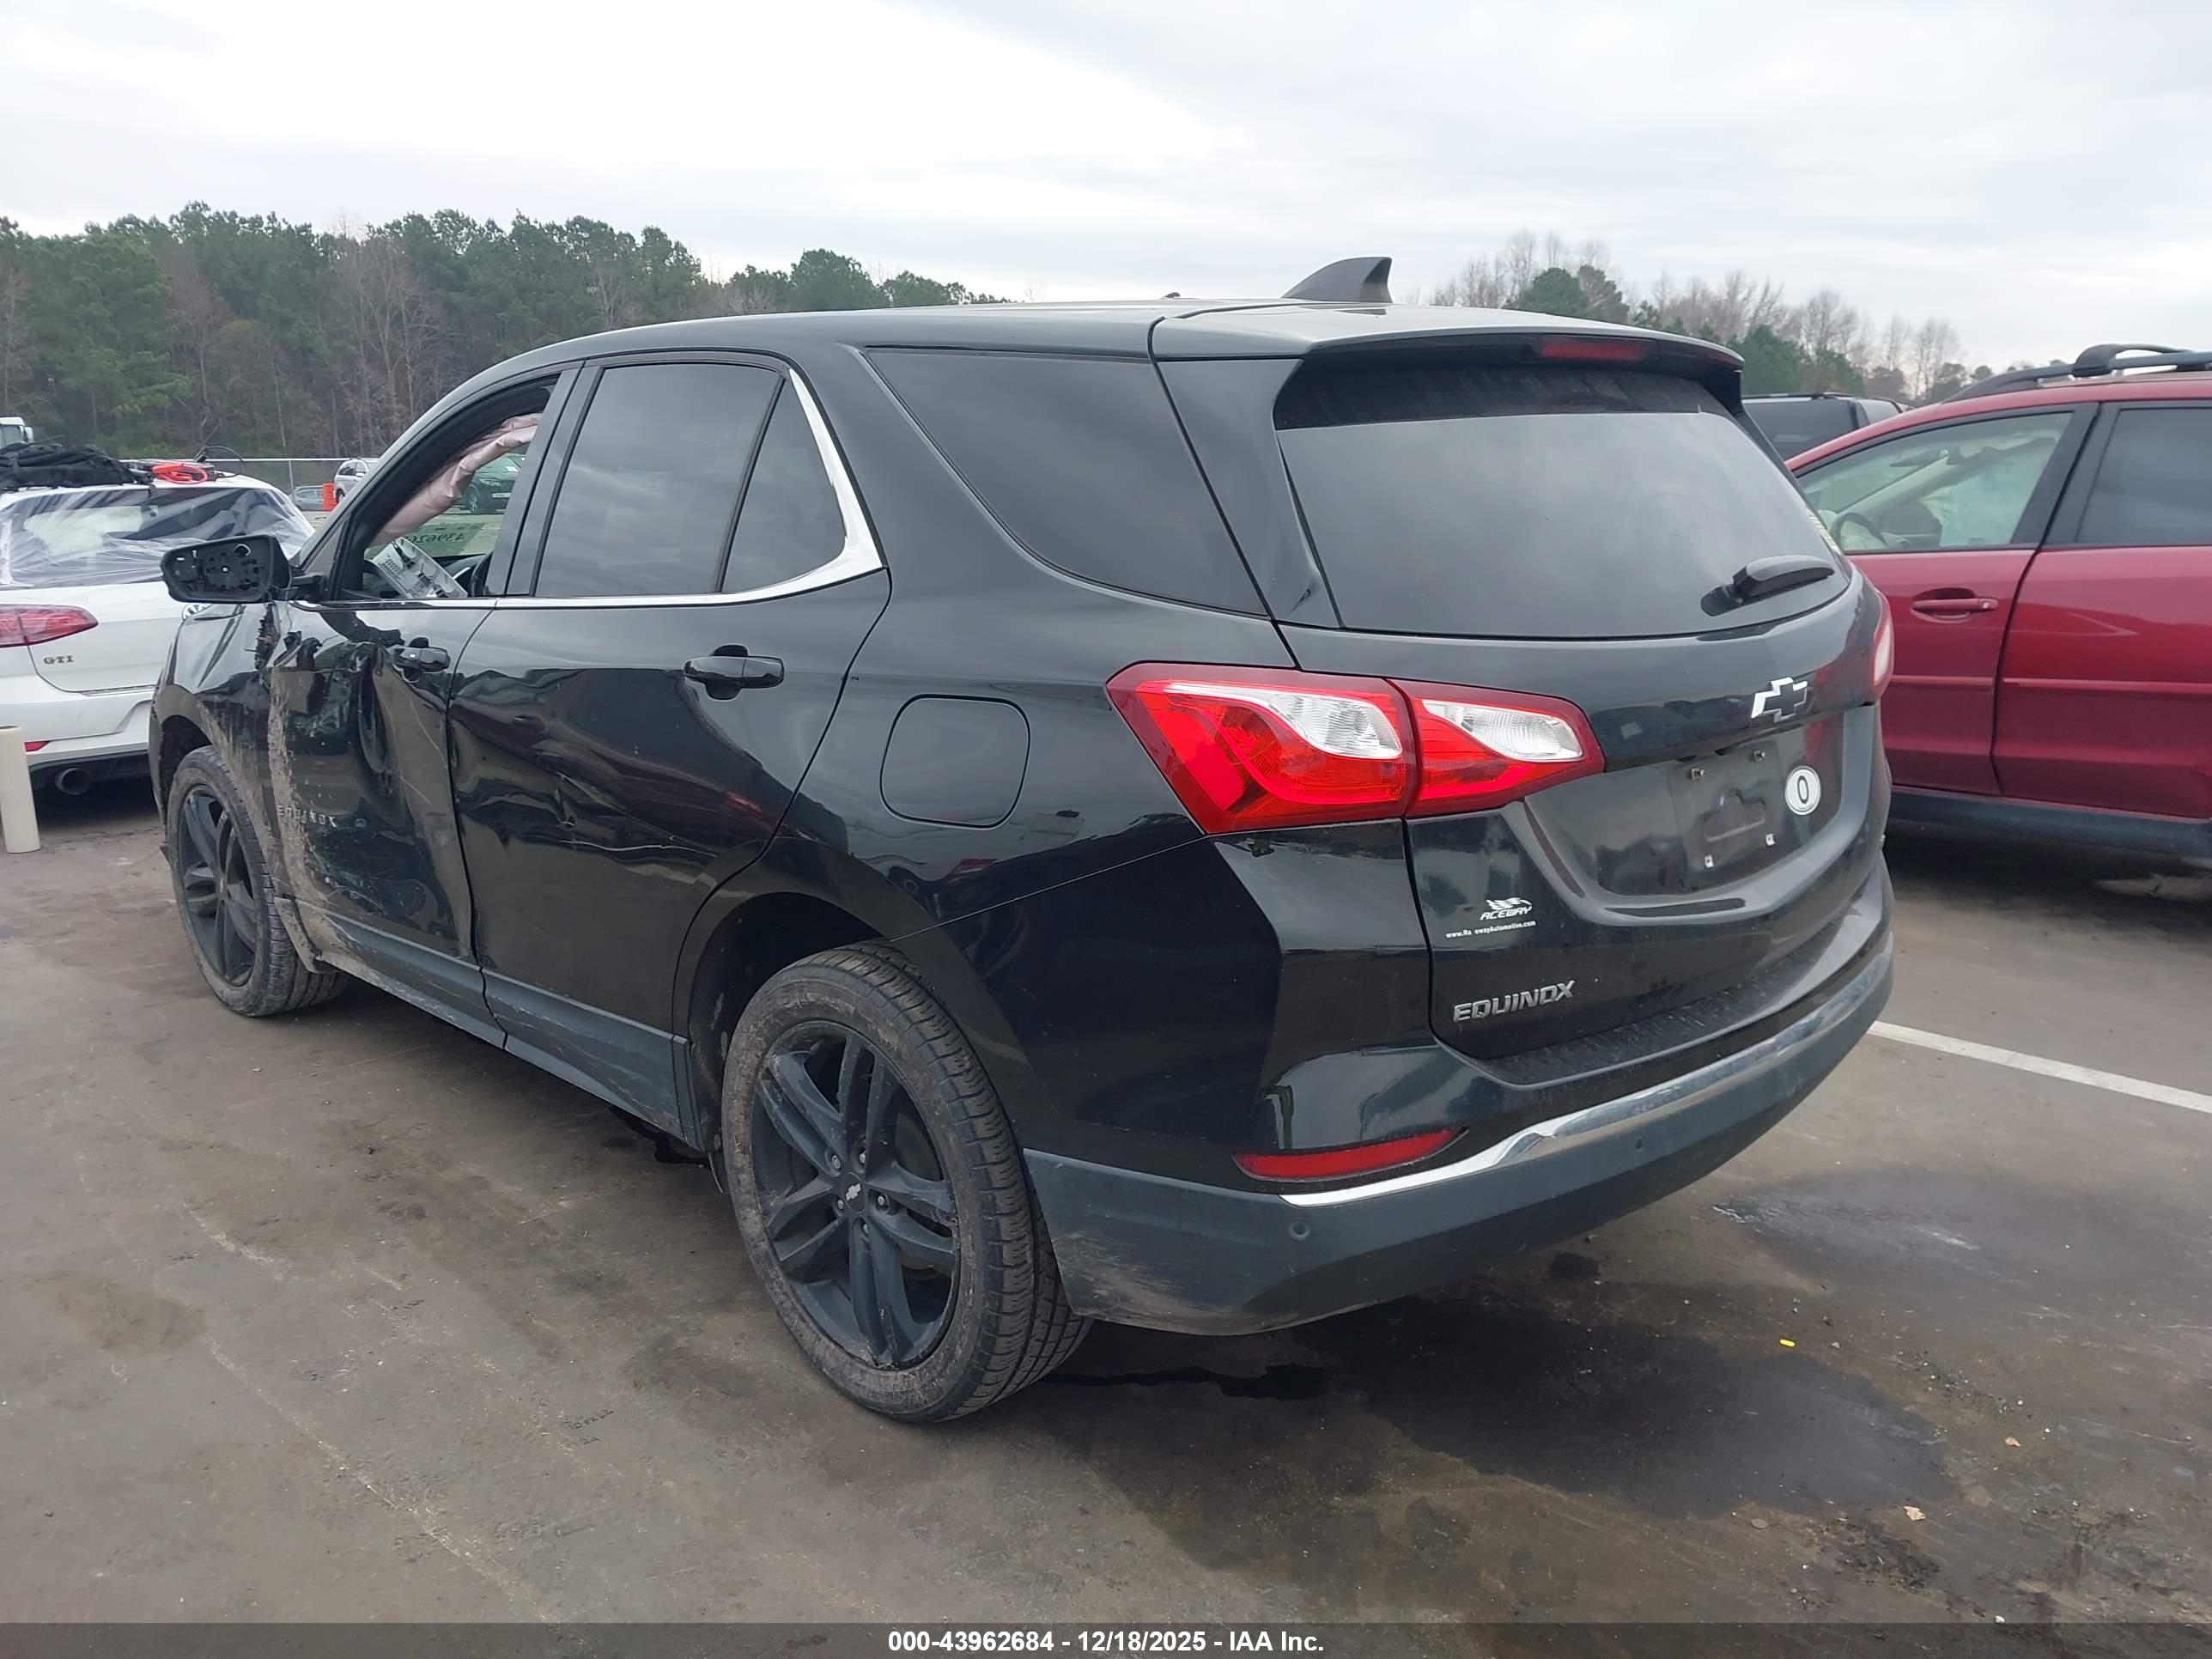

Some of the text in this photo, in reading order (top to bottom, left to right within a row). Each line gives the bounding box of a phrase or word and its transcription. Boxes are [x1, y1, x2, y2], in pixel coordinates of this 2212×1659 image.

[43, 654, 75, 665] GTI
[1480, 906, 1533, 921] ACEWAY
[1453, 980, 1576, 1023] EQUINOX
